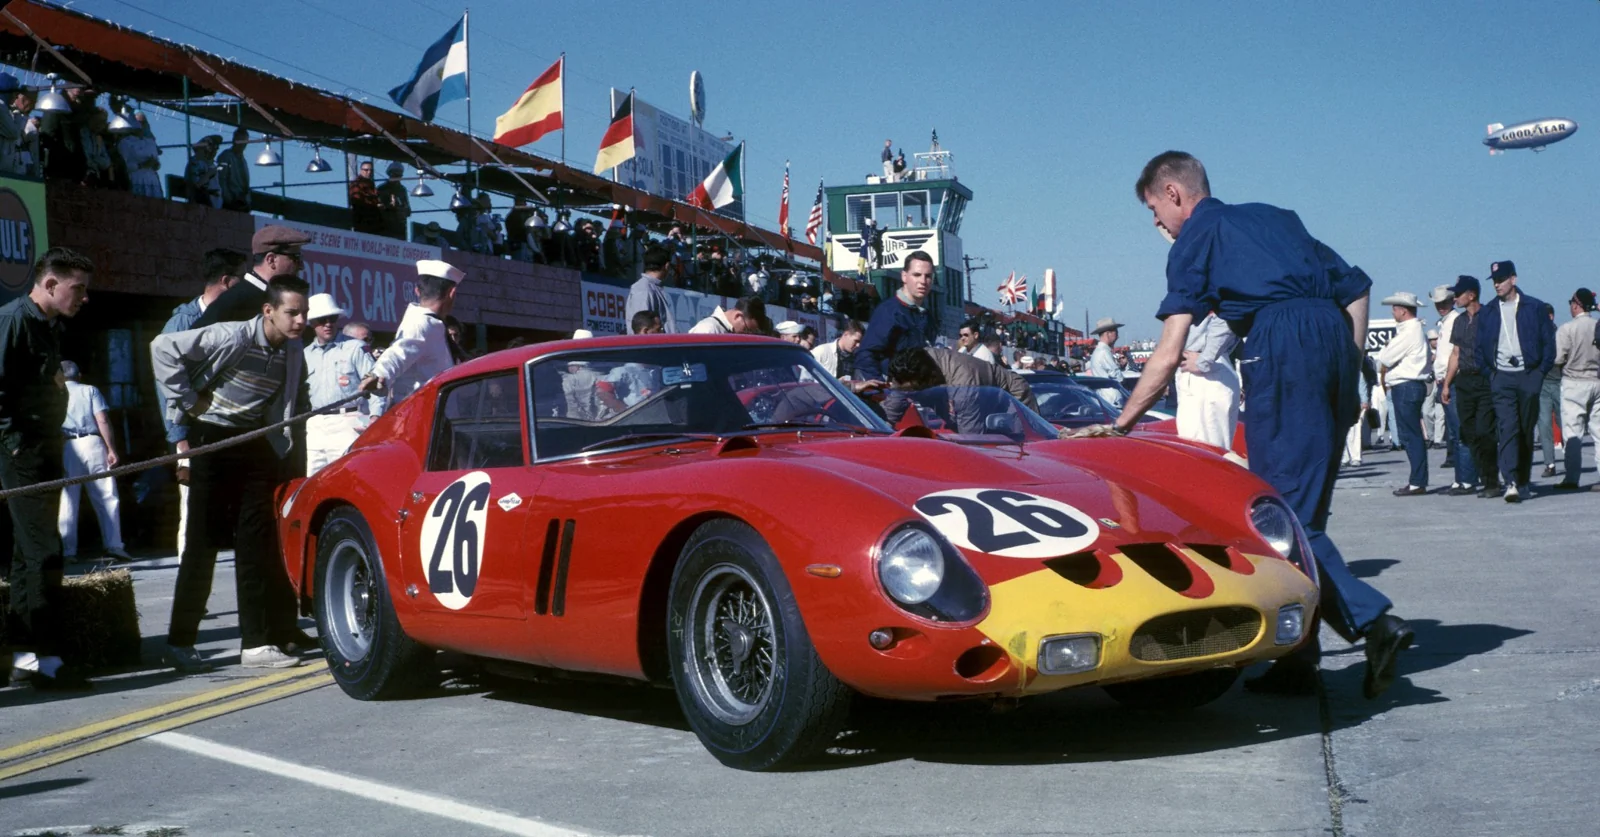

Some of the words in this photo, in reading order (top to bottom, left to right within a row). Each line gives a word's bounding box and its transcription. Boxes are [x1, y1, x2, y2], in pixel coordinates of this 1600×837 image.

[1501, 123, 1566, 141] GOODYEAR
[0, 218, 29, 262] ULF
[320, 233, 341, 249] SCENE
[343, 237, 359, 251] WITH
[360, 269, 397, 323] CAR
[587, 290, 626, 320] COBR
[428, 480, 491, 598] 26
[914, 489, 1089, 553] 26
